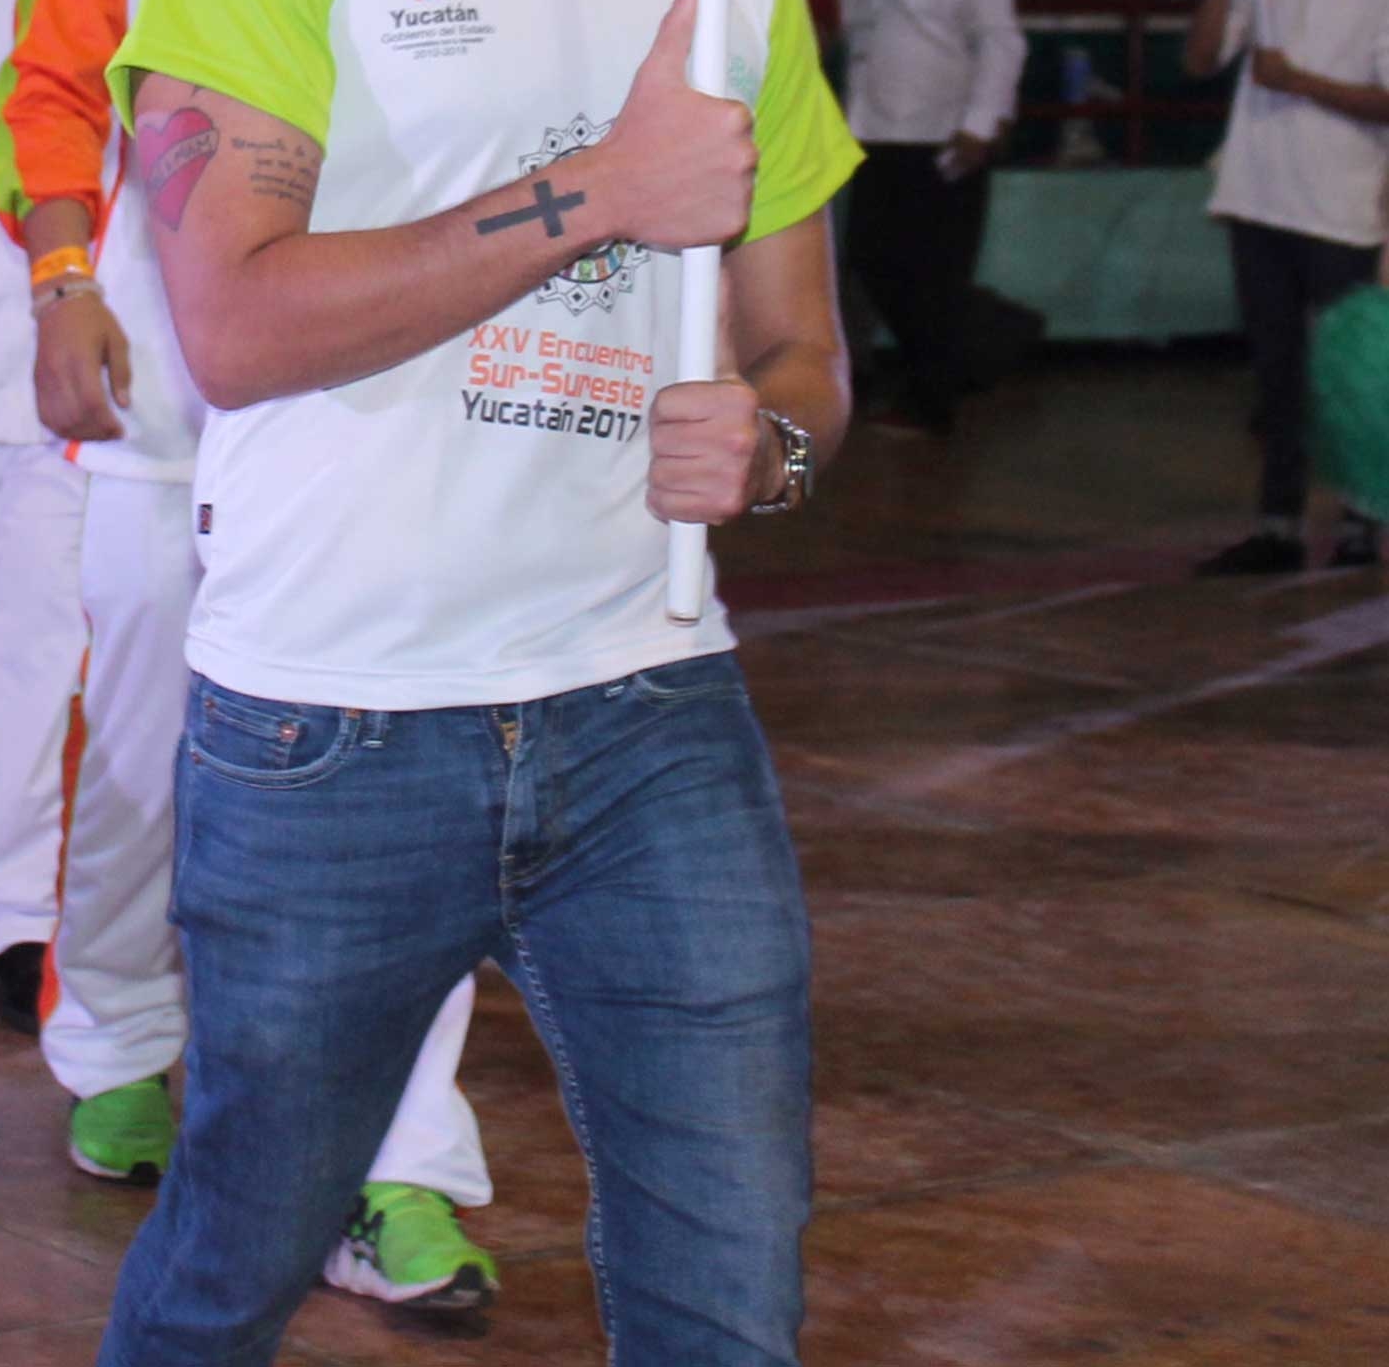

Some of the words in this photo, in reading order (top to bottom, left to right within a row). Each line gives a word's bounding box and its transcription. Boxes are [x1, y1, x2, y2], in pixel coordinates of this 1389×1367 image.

[389, 3, 479, 28] Yucatán
[468, 324, 531, 353] XXV
[538, 331, 654, 374] Encuentro
[468, 354, 645, 409] Sur-Sureste
[461, 390, 574, 432] Yucatán
[576, 404, 642, 443] 2017
